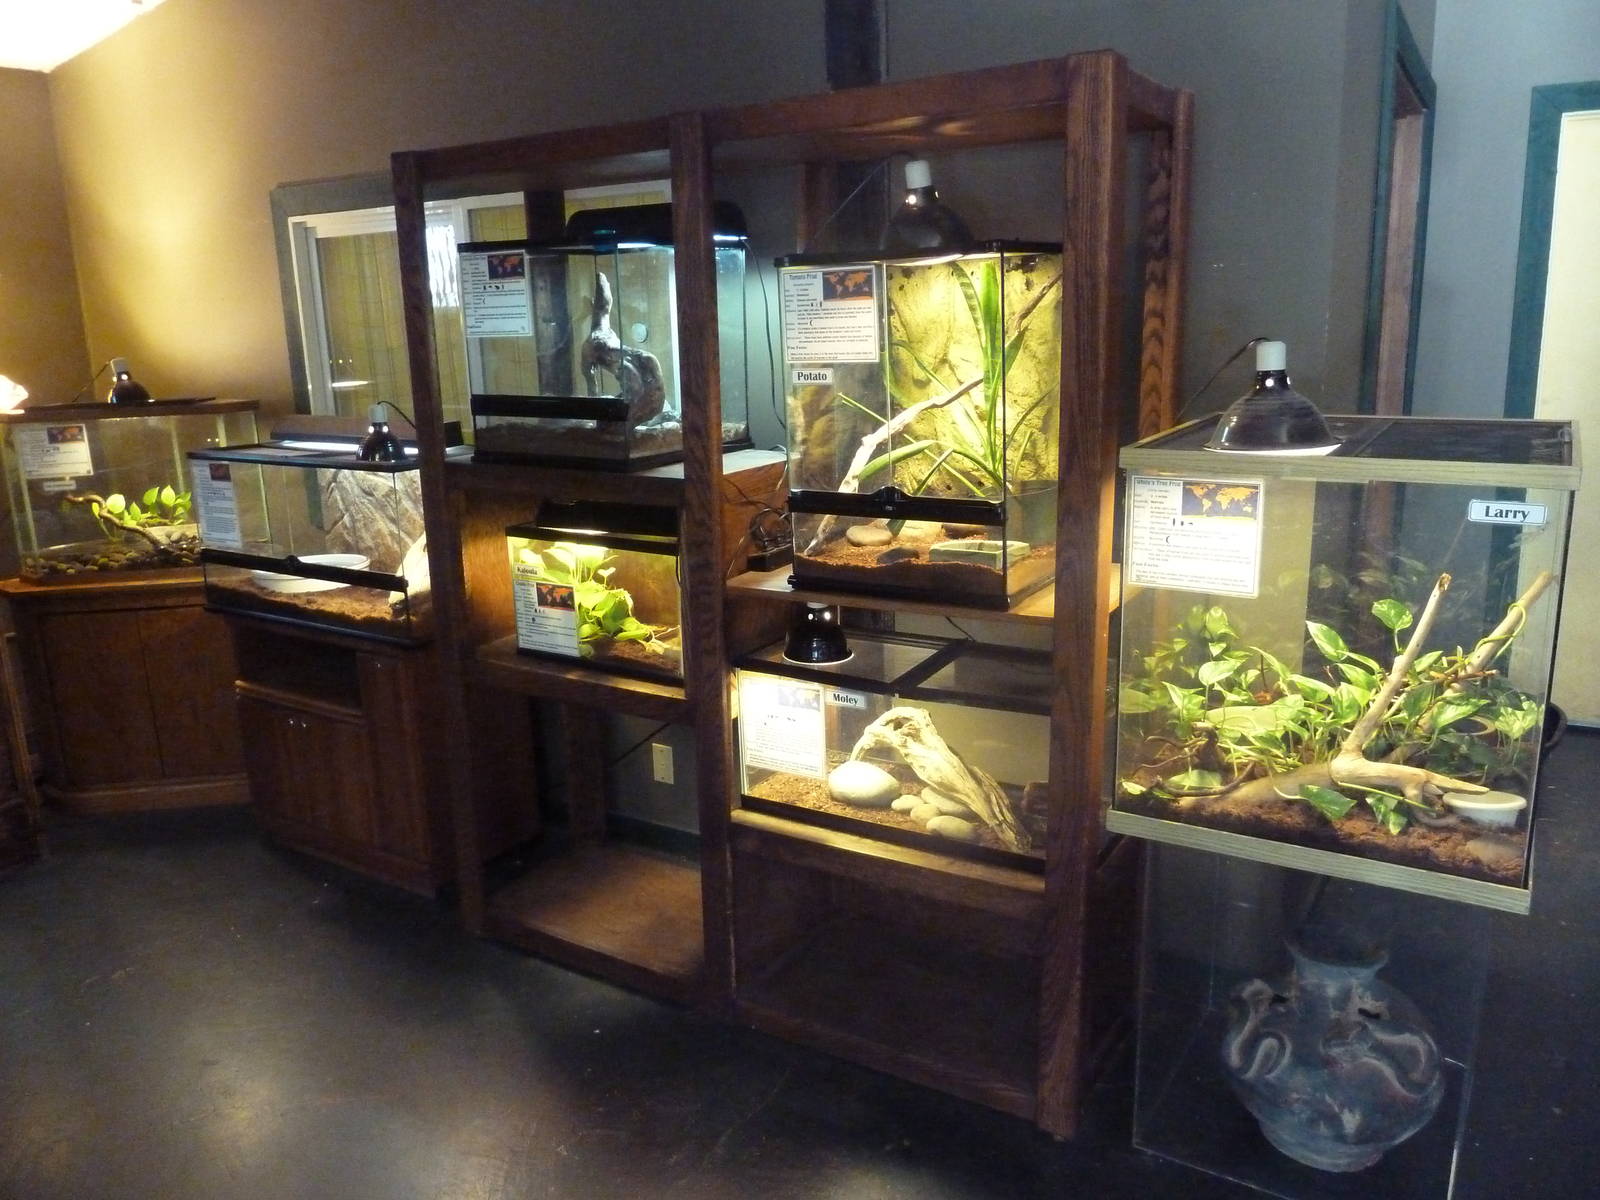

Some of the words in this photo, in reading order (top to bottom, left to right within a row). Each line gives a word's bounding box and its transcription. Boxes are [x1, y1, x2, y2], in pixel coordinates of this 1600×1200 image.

[797, 371, 827, 381] Potato
[1485, 505, 1530, 522] Larry
[833, 693, 858, 706] Moley
